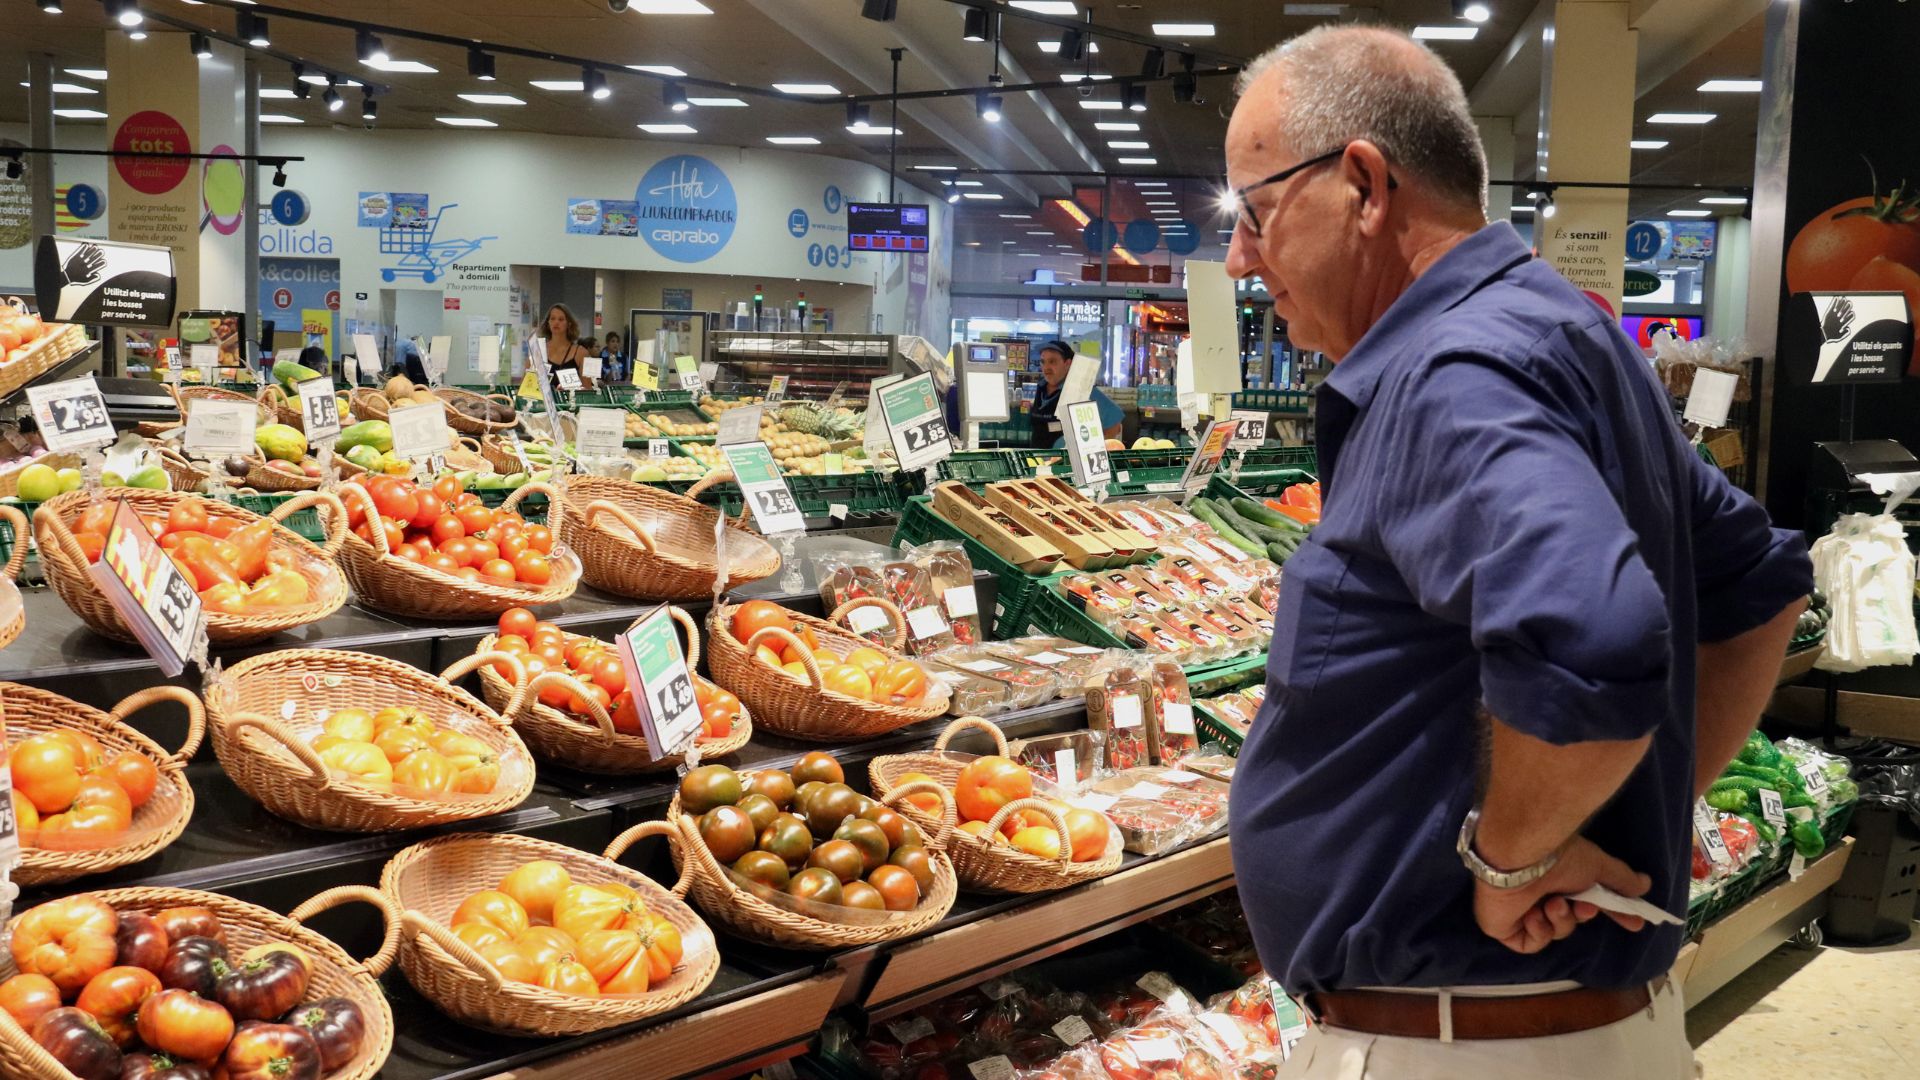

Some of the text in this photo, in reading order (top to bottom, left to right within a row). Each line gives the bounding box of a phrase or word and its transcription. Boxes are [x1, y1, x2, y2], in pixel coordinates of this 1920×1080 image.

[123, 123, 180, 136] Comparem
[129, 137, 173, 153] tots
[648, 160, 719, 209] Hola
[78, 192, 86, 211] 5
[284, 198, 292, 217] 6
[147, 204, 186, 213] productes
[639, 205, 736, 223] LIURECOMPRADOR
[156, 224, 188, 232] EROSKI
[1554, 227, 1612, 241] És senzill:
[260, 229, 332, 254] ollida
[652, 228, 719, 245] caprabo
[1635, 231, 1650, 253] 12
[1565, 242, 1599, 252] si som
[1557, 253, 1606, 265] més cars,
[452, 263, 507, 273] Repartiment
[1567, 267, 1606, 277] tornem
[466, 273, 500, 281] domicili
[104, 287, 166, 300] Utilitzi els guants
[106, 299, 117, 307] les
[118, 300, 143, 309] bosses
[101, 311, 147, 320] per servir-se
[1853, 341, 1903, 351] Utilitzi els guants
[1854, 354, 1863, 362] les
[1863, 353, 1884, 362] bosses
[1848, 365, 1885, 376] per servir-se
[1075, 406, 1094, 424] BIO
